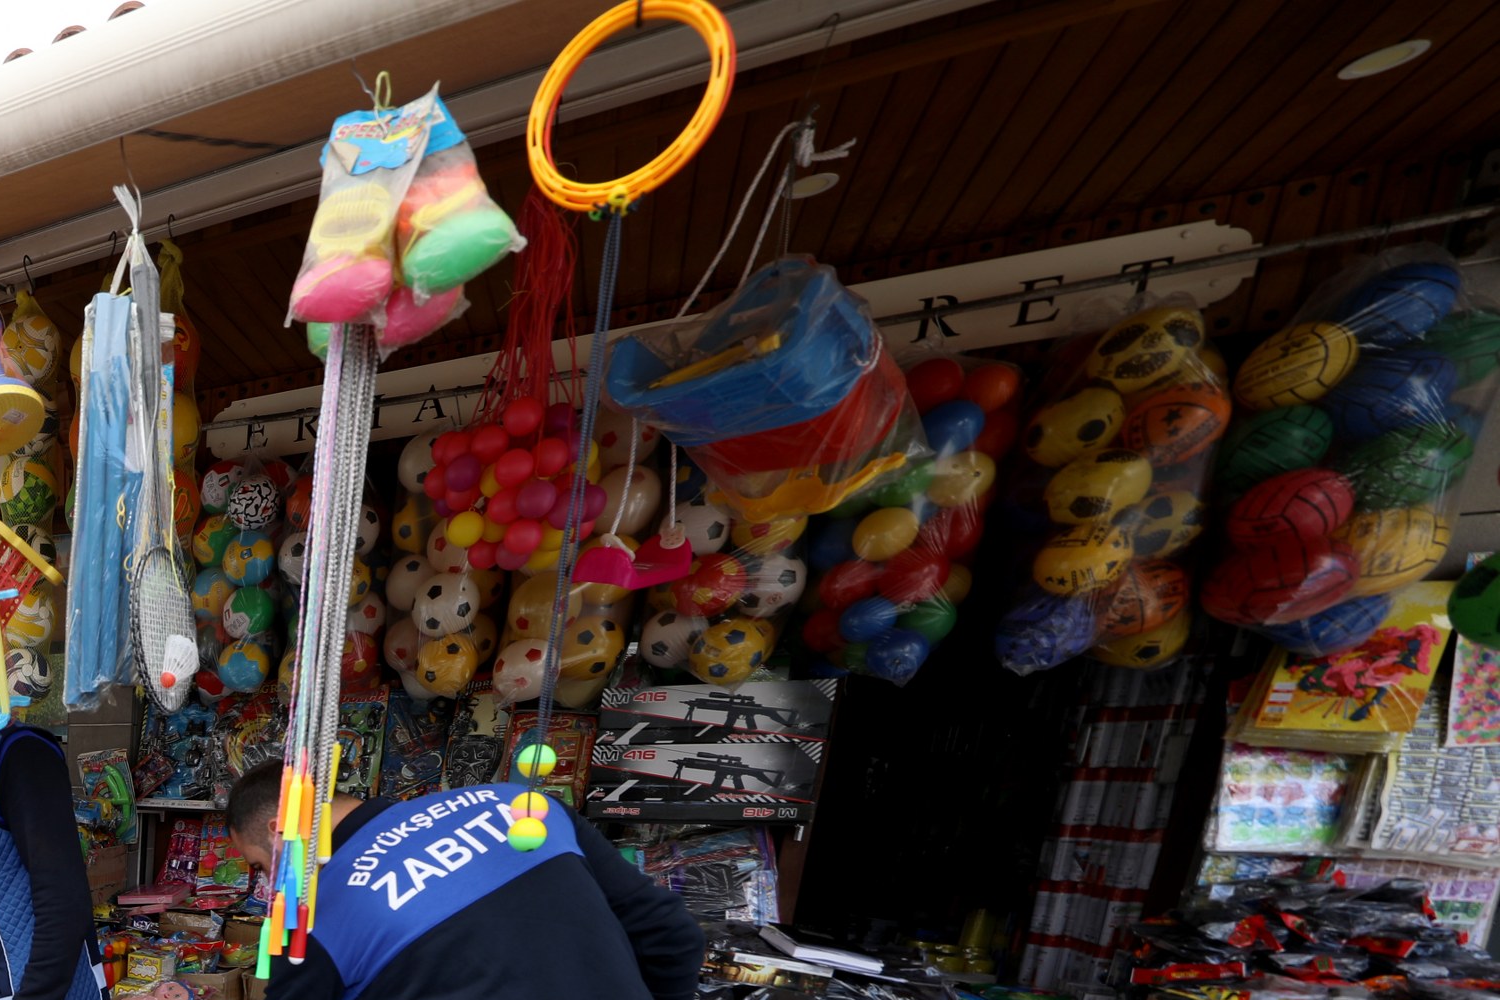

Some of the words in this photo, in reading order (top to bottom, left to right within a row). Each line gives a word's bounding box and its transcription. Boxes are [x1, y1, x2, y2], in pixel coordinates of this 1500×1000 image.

[610, 692, 630, 704] M
[632, 691, 668, 702] 416
[600, 750, 619, 761] M
[623, 749, 657, 760] 416
[602, 806, 641, 816] Sniper
[742, 806, 776, 818] 416
[778, 807, 798, 818] M
[346, 789, 500, 887] BÜYÜKŞEHİR
